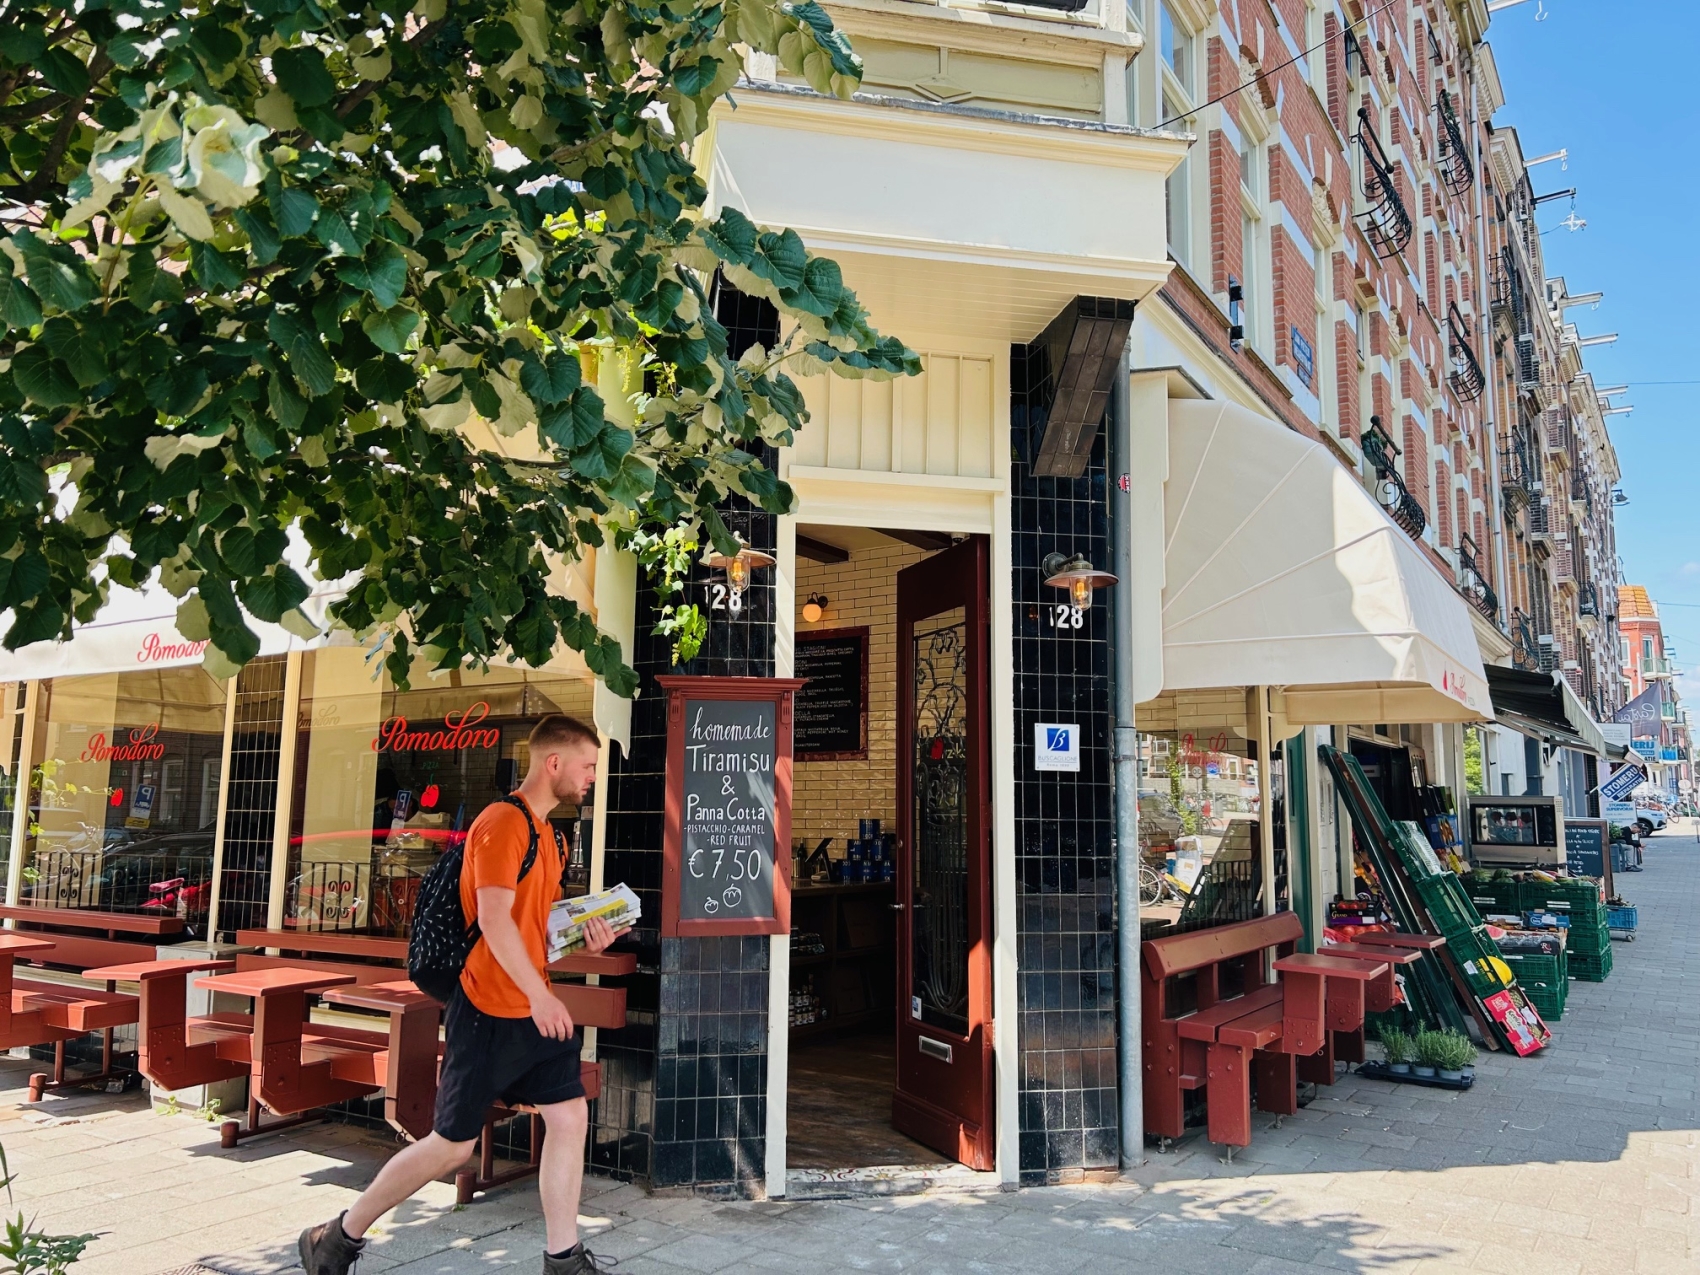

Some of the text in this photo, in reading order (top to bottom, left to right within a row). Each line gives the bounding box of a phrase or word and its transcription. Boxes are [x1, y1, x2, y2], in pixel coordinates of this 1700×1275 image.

[704, 584, 742, 610] 128
[1049, 604, 1084, 629] 128
[137, 632, 210, 662] Pomodo
[371, 701, 500, 752] Pomodoro
[689, 706, 772, 741] homemade
[80, 722, 165, 763] Pomodoro
[1633, 741, 1655, 749] ERIJ
[685, 744, 770, 773] Tiramisu
[721, 775, 736, 796] &
[687, 793, 765, 821] Panna Cotta
[728, 835, 751, 846] FRUIT
